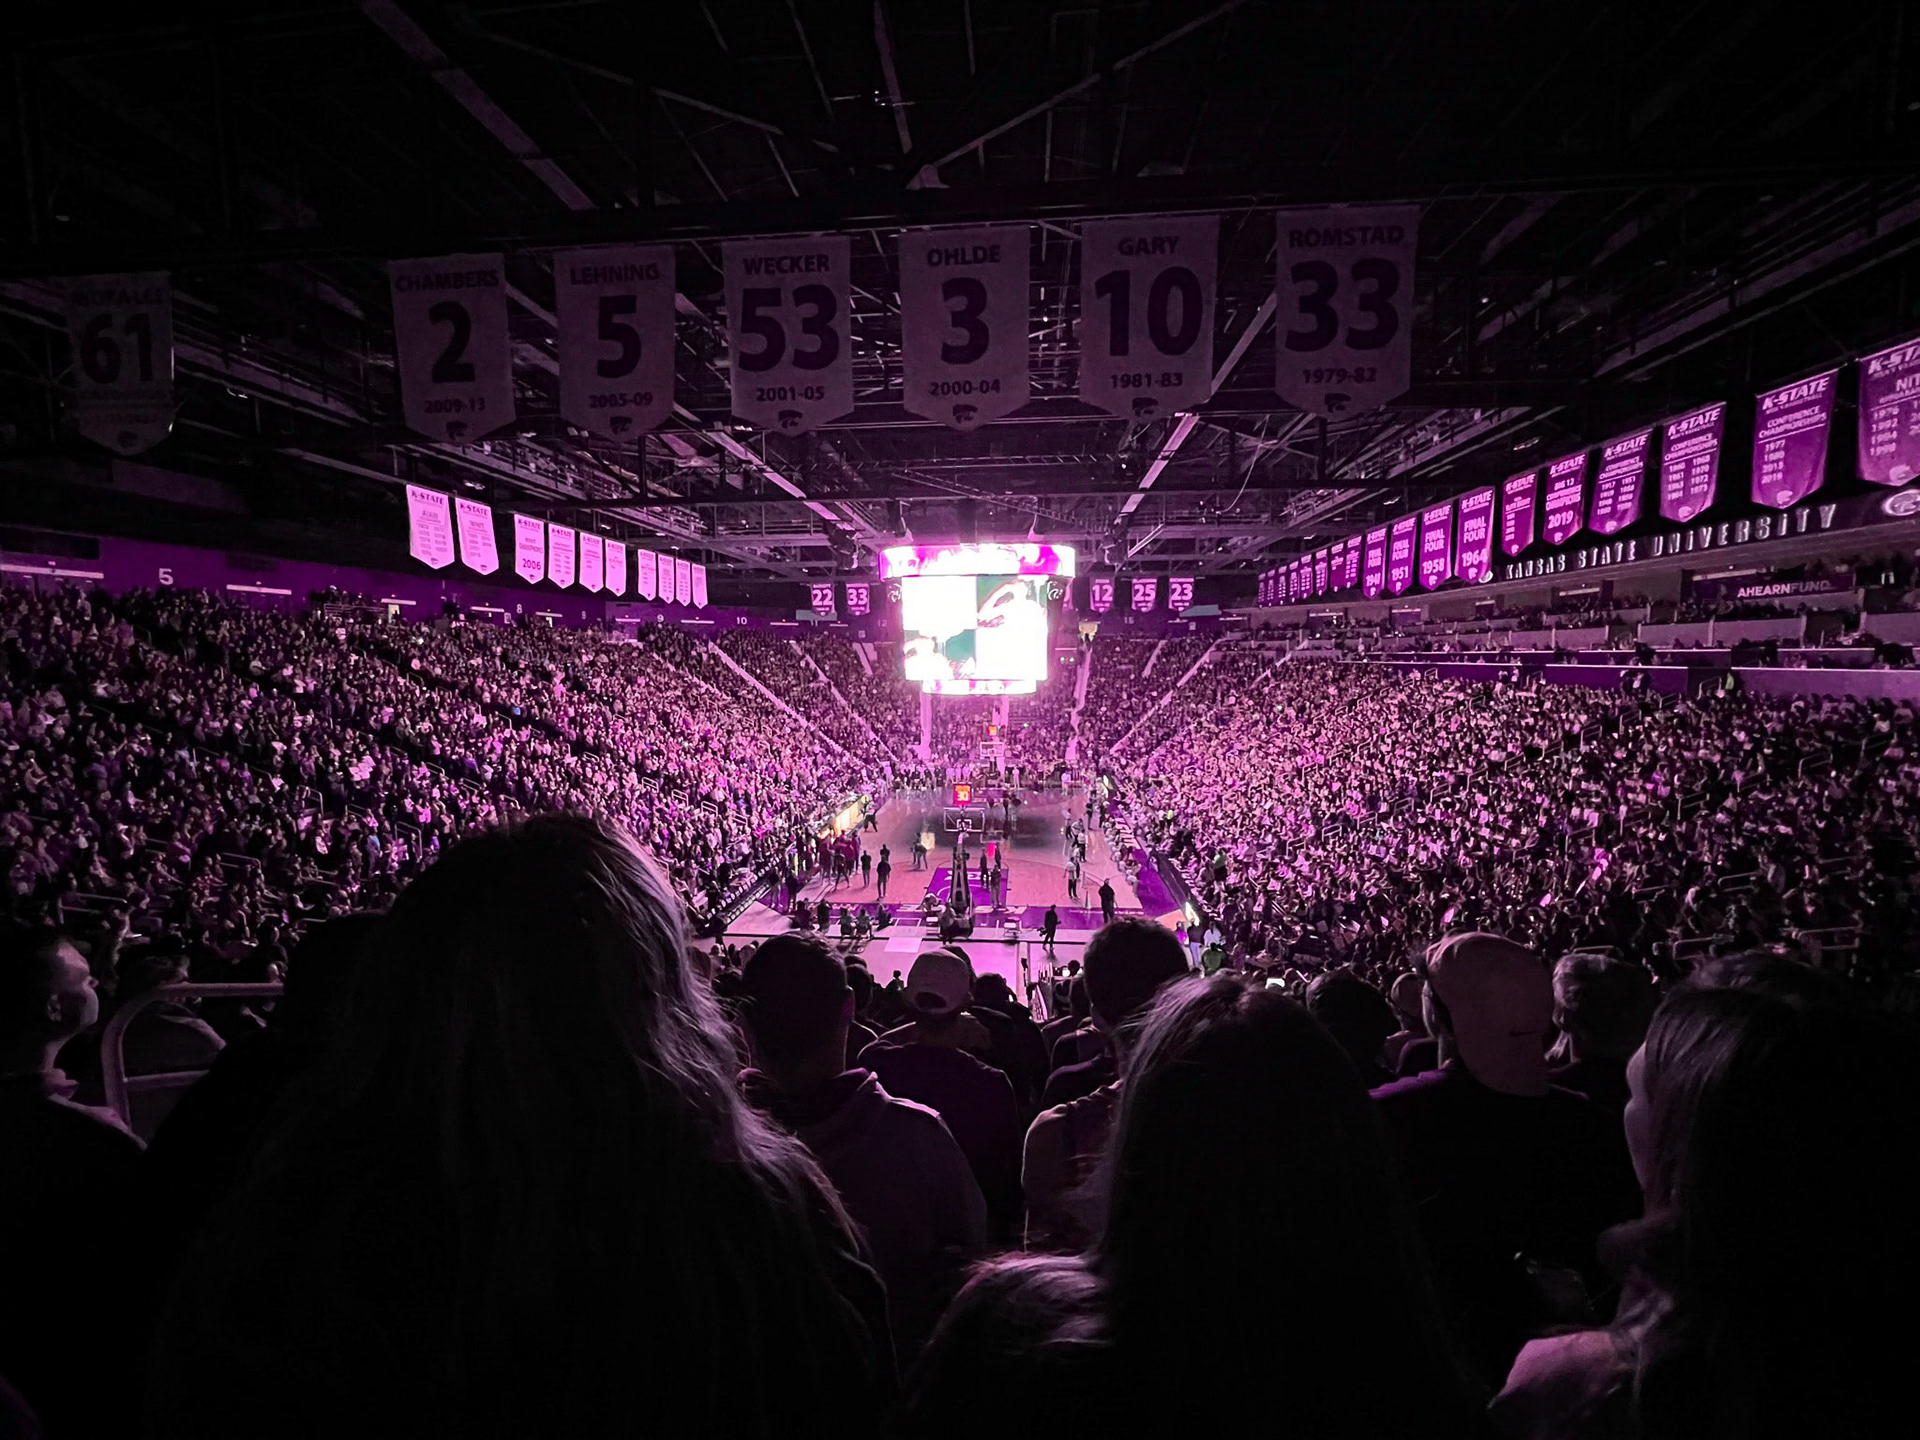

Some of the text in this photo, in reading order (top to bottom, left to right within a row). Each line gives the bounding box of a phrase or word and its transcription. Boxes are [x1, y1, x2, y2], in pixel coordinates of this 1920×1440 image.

[1289, 225, 1405, 248] ROMSTAD
[1118, 236, 1179, 256] GARY
[743, 254, 830, 275] WECKER
[927, 245, 1000, 267] OHLDE
[395, 269, 499, 291] CHAMBERS
[570, 263, 659, 285] LEHNING
[1095, 266, 1202, 356] 10
[1285, 258, 1399, 352] 33
[738, 284, 839, 372] 53
[941, 277, 989, 365] 3
[429, 301, 475, 383] 2
[597, 295, 641, 379] 5
[81, 313, 153, 384] 61
[1111, 372, 1183, 388] 1981-83
[1302, 367, 1377, 384] 1979-82
[756, 386, 825, 401] 2001-05
[930, 379, 1000, 395] 2000-04
[1762, 377, 1830, 411] K-STATE
[424, 398, 485, 414] 2009-13
[589, 392, 653, 408] 2005-09
[1668, 408, 1721, 436] K-STATE
[1604, 434, 1649, 458] K-STATE
[1549, 454, 1586, 475] K-STATE
[411, 490, 444, 505] K-STATE
[460, 503, 489, 517] K-STATE
[1464, 516, 1486, 532] FINAL
[1548, 510, 1574, 529] 2019
[1425, 528, 1445, 543] FINAL
[1463, 528, 1485, 543] FOUR
[1506, 503, 1837, 580] KANSAS STATE UNIVERSITY
[1424, 539, 1444, 553] FOUR
[523, 558, 541, 570] 2006
[1422, 557, 1445, 574] 1958
[1462, 548, 1488, 567] 1964
[158, 568, 174, 586] 5
[1391, 565, 1409, 581] 1951
[812, 588, 833, 606] 22
[847, 588, 868, 606] 33
[1092, 584, 1113, 601] 12
[1133, 584, 1156, 601] 25
[1171, 583, 1193, 601] 23
[516, 604, 523, 614] 8
[657, 614, 664, 623] 9
[736, 616, 748, 625] 10
[956, 790, 969, 802] 30
